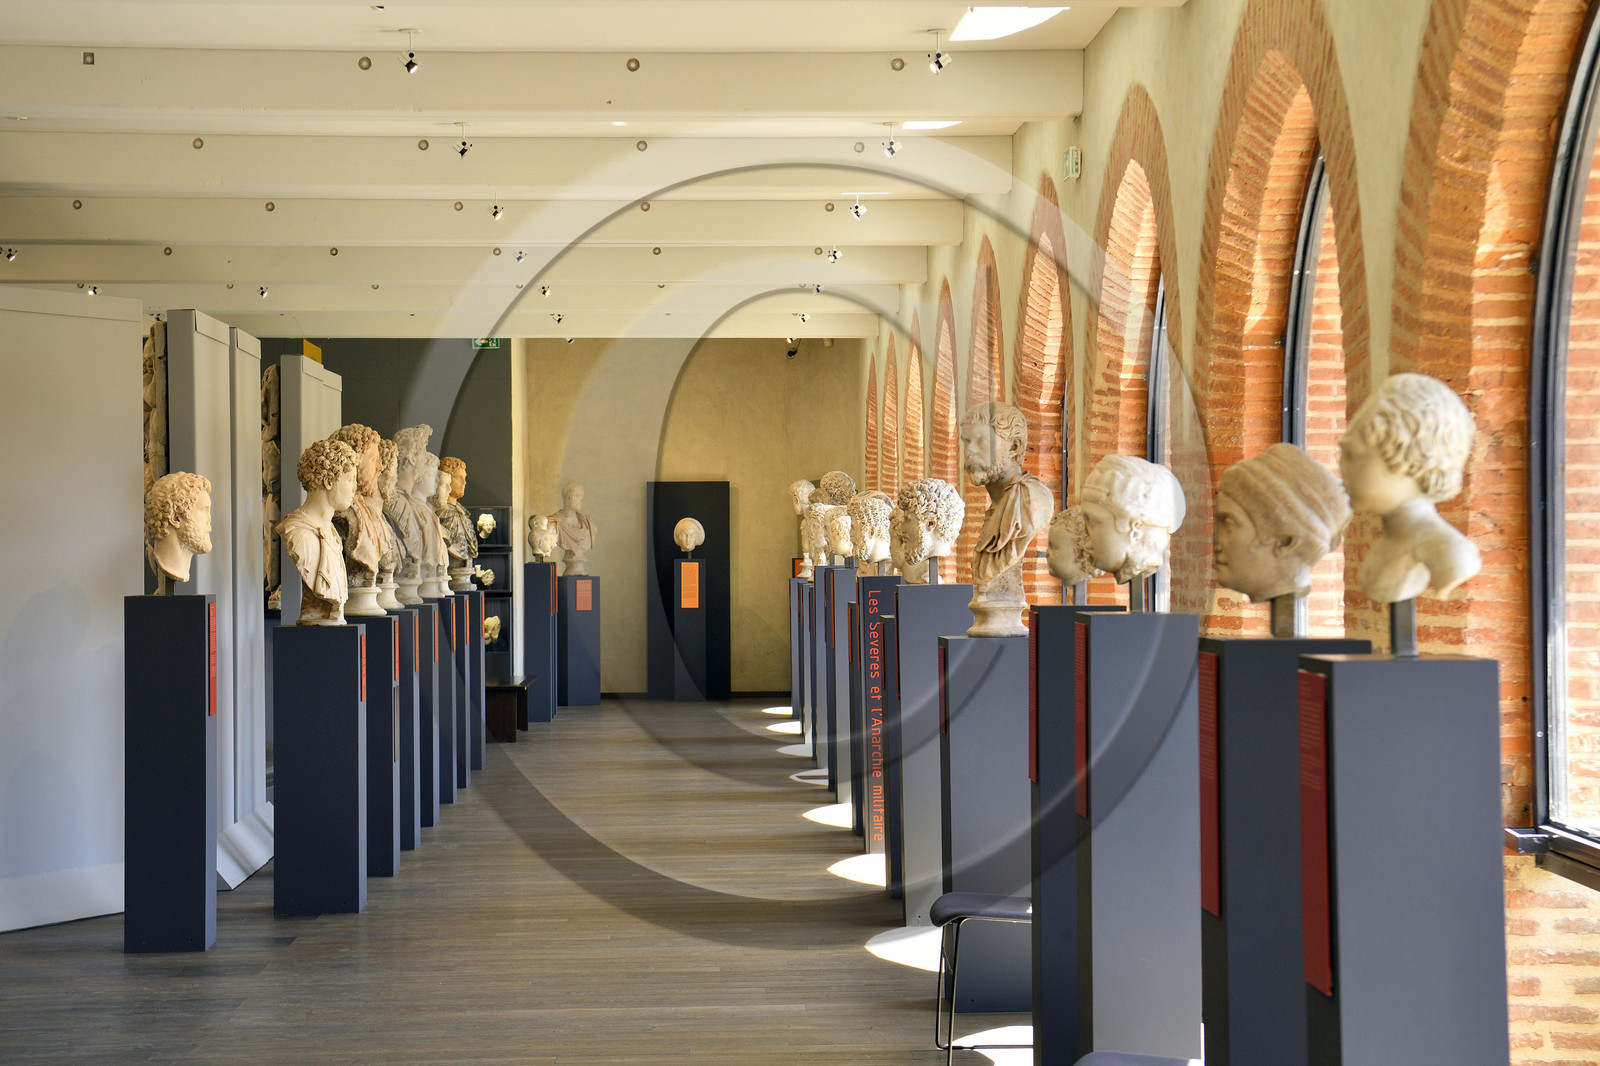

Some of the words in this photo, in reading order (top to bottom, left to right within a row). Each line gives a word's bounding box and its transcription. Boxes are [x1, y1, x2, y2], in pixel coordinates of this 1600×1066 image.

[868, 590, 881, 614] Les
[870, 686, 882, 701] et
[871, 708, 884, 778] l'Anarchie
[872, 785, 884, 842] militaire
